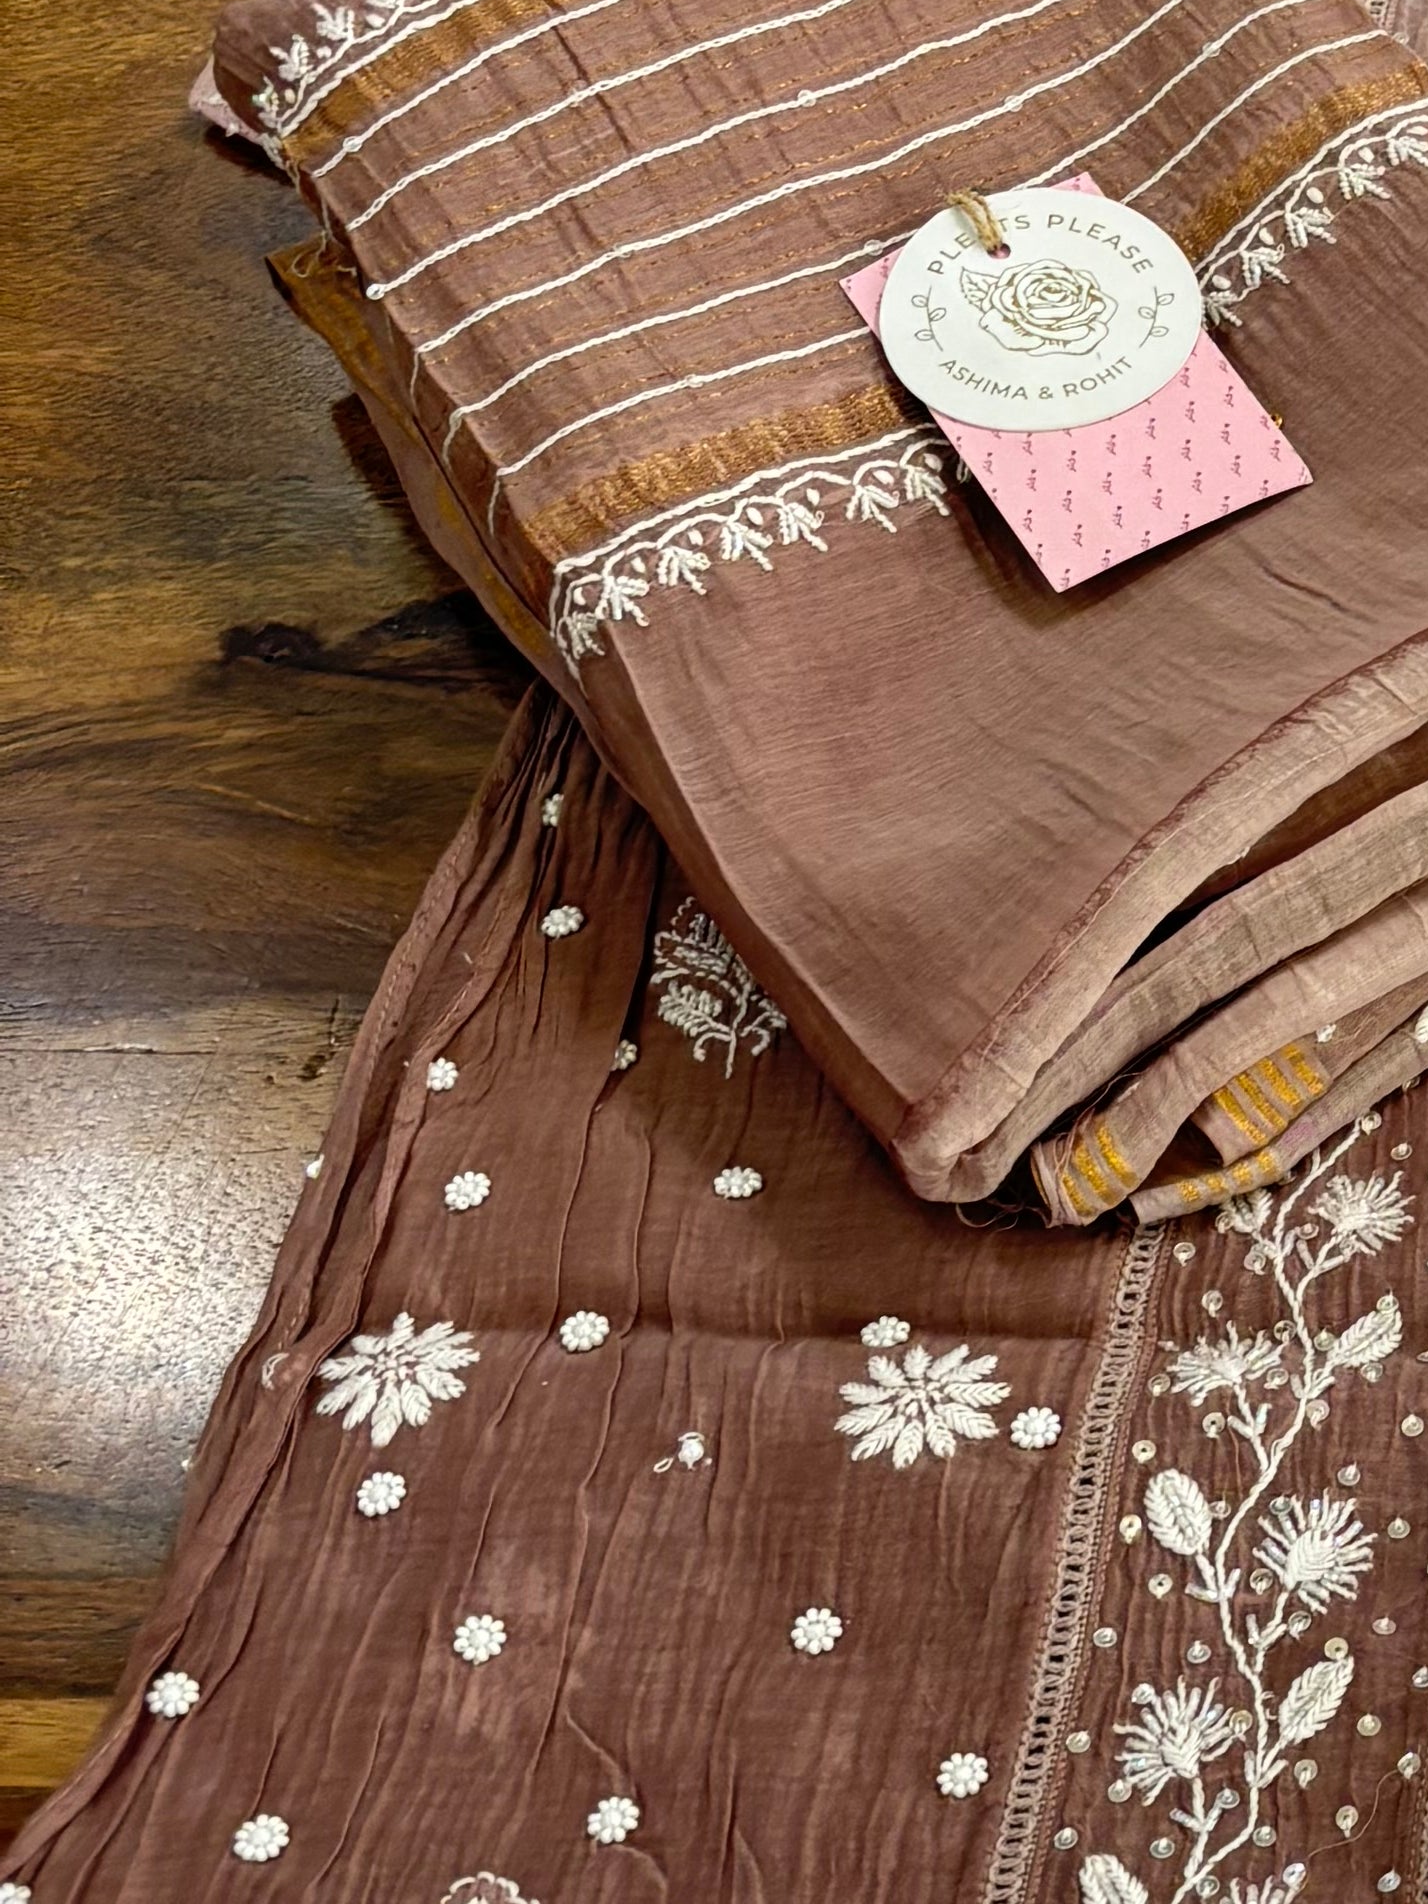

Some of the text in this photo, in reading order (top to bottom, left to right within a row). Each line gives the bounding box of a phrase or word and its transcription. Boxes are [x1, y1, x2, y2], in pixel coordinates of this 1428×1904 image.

[927, 213, 1154, 275] PLETS PLEASE
[938, 356, 1133, 400] ASHIMA & ROHIT
